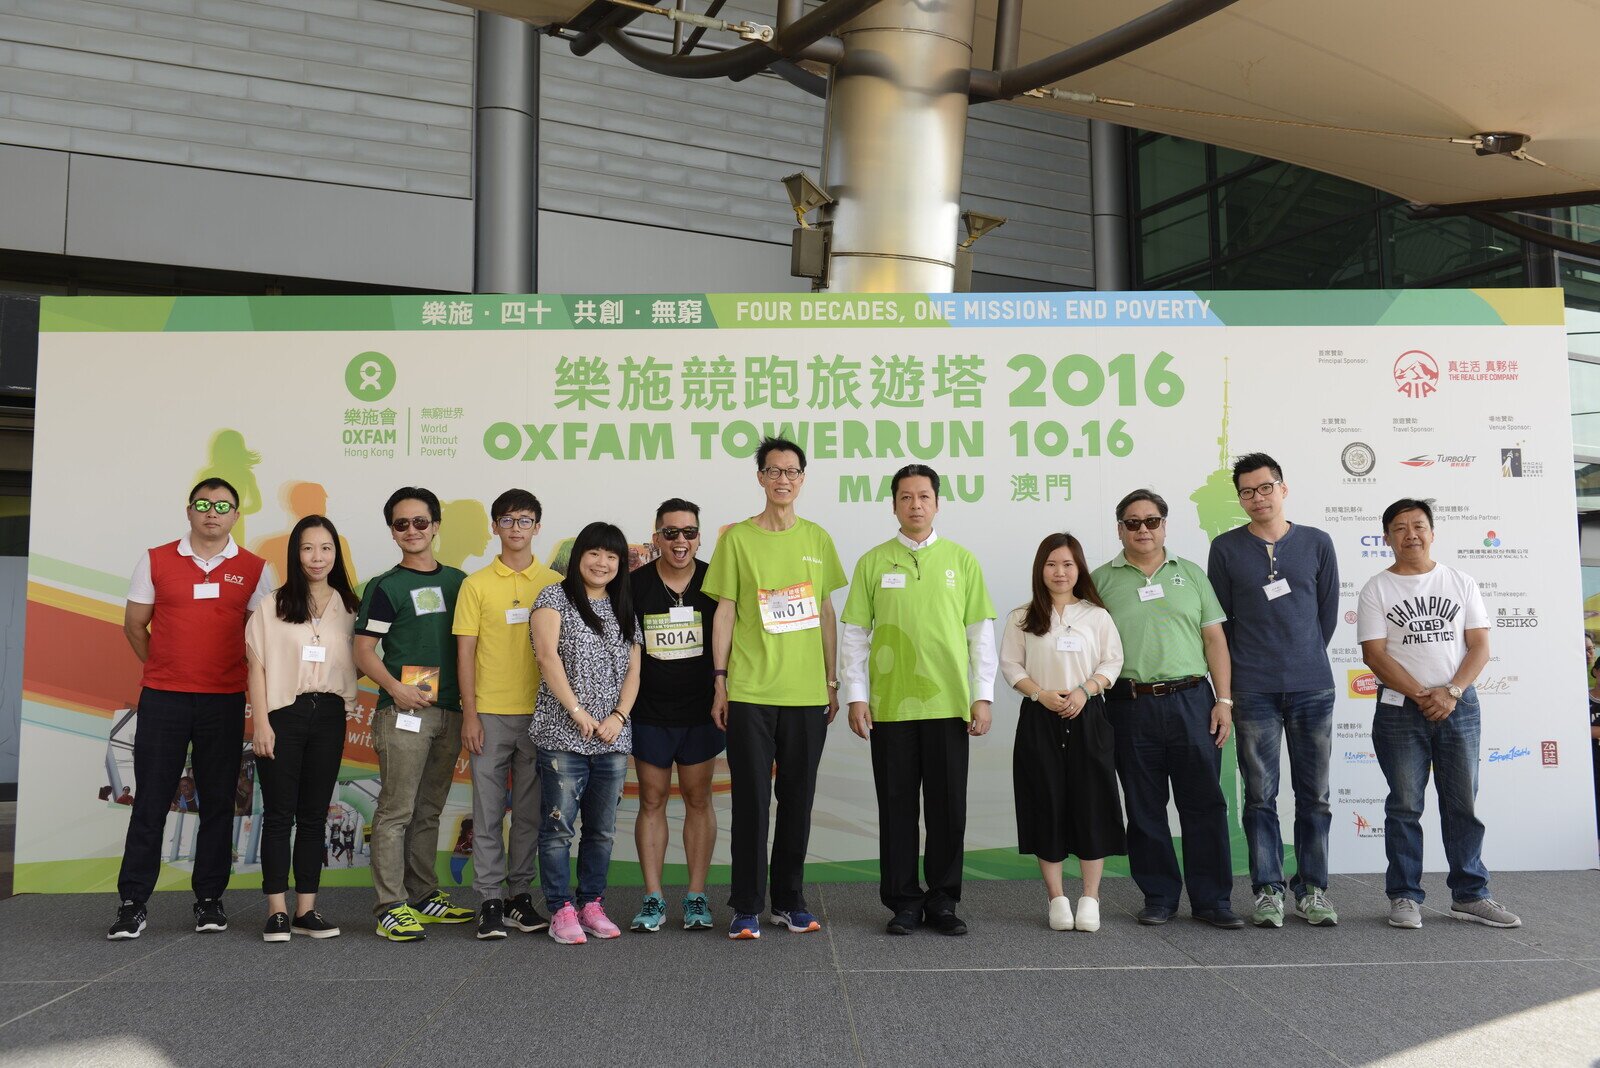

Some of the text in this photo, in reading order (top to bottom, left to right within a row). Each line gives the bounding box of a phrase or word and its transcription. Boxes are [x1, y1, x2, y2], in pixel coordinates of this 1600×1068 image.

[736, 299, 1211, 323] FOUR DECADES, ONE MISSION: END POVERTY
[1448, 360, 1480, 373] 真生活
[554, 350, 1186, 412] 樂施競跑旅遊塔 2016
[1396, 381, 1437, 399] AIA
[343, 407, 398, 426] 樂施會
[420, 407, 465, 420] 無窮世界
[420, 423, 448, 434] World
[342, 429, 397, 445] OXFAM
[420, 435, 458, 445] Without
[483, 421, 675, 462] OXFAM
[1009, 418, 1134, 459] 10.16
[344, 448, 394, 459] Hong Kong
[420, 446, 457, 459] Poverty
[838, 472, 1072, 504] MAAU 澳門
[224, 573, 244, 584] EA7
[1386, 596, 1461, 628] CHAMPION
[1411, 619, 1443, 632] NY-19
[1496, 618, 1538, 628] SEIKO
[655, 630, 697, 646] R01A
[1402, 631, 1455, 645] ATHLETICS
[348, 731, 375, 749] wit
